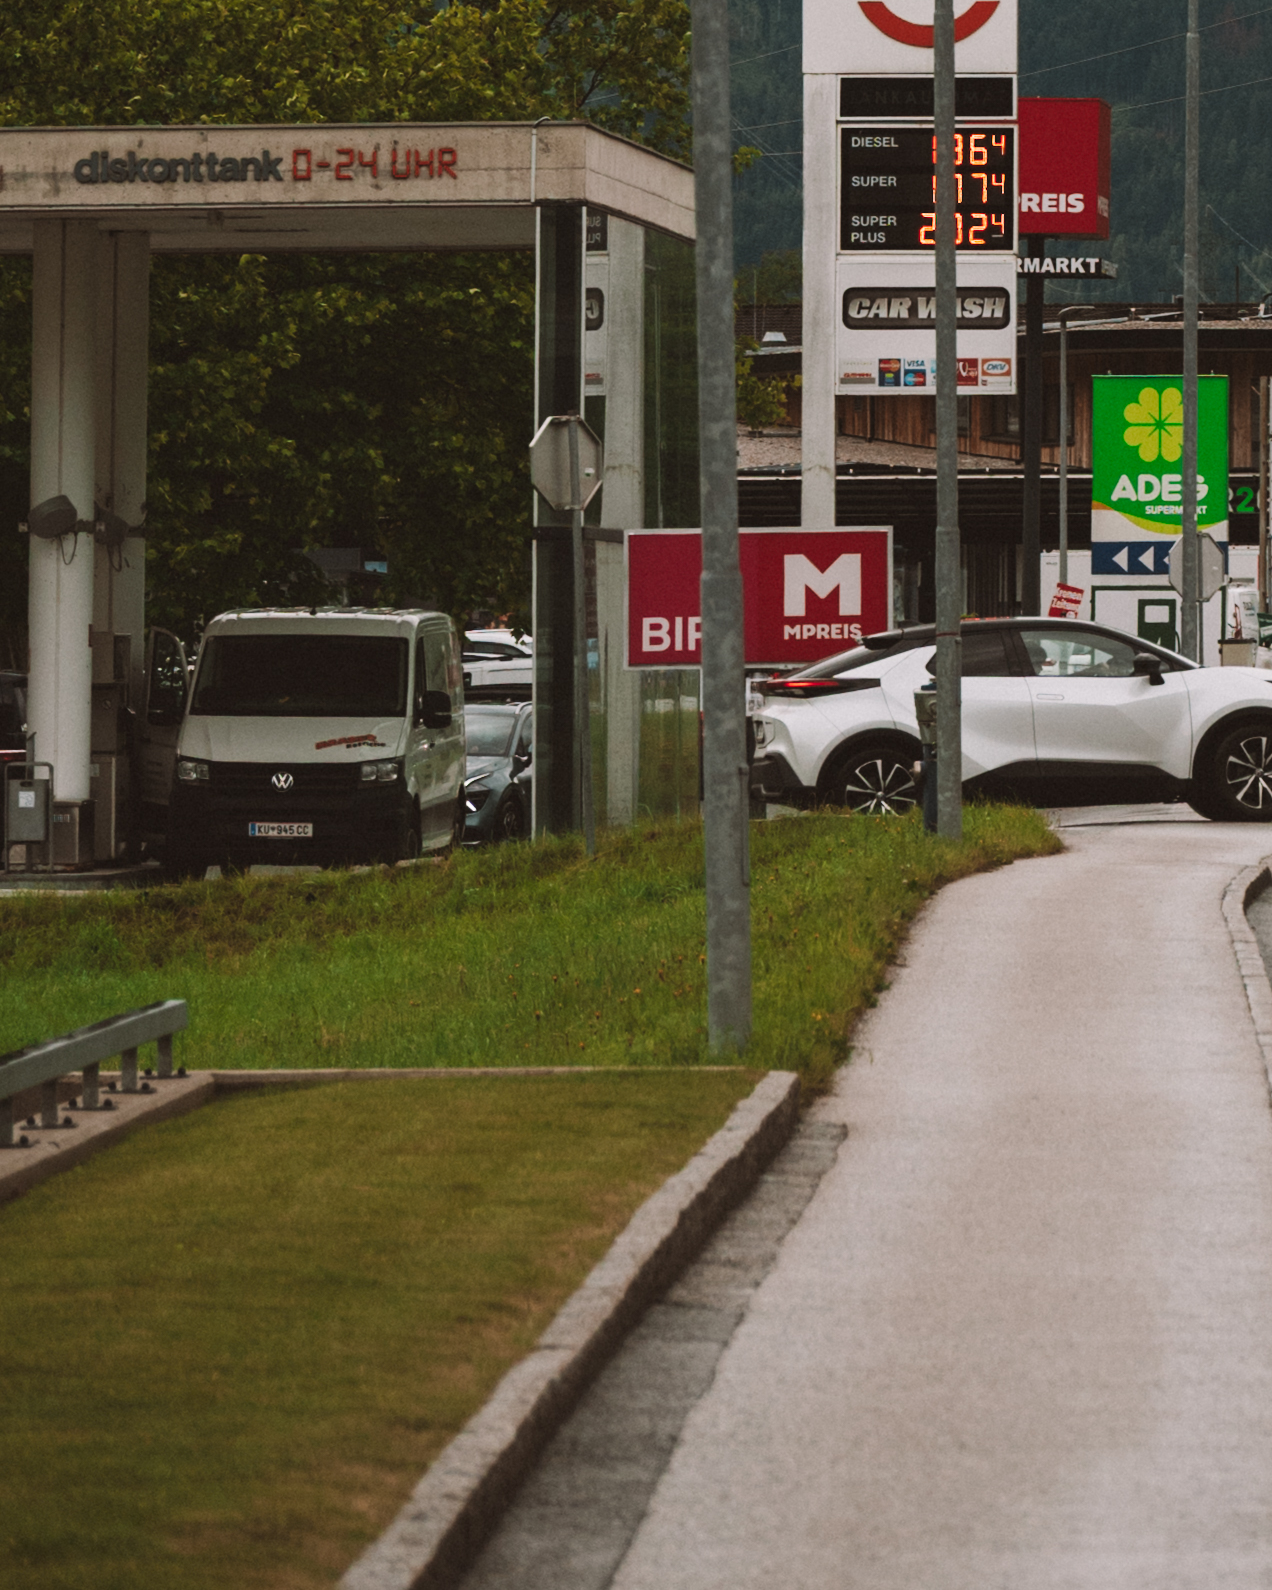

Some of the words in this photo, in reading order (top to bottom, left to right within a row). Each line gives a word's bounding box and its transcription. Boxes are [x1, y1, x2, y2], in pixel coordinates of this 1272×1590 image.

[851, 137, 898, 148] DIESEL
[74, 150, 283, 184] diskonttank
[292, 148, 378, 180] 0-24
[391, 147, 457, 180] UHR
[851, 176, 897, 187] SUPER
[1018, 192, 1085, 213] REIS
[851, 216, 897, 227] SUPER
[851, 232, 886, 243] PLUS
[848, 297, 912, 319] CAR
[986, 363, 1006, 371] DKV
[1145, 505, 1208, 515] SUPERMKT
[783, 623, 862, 640] MPREIS
[257, 824, 270, 834] KU
[276, 824, 295, 834] 945
[296, 824, 309, 834] CC
